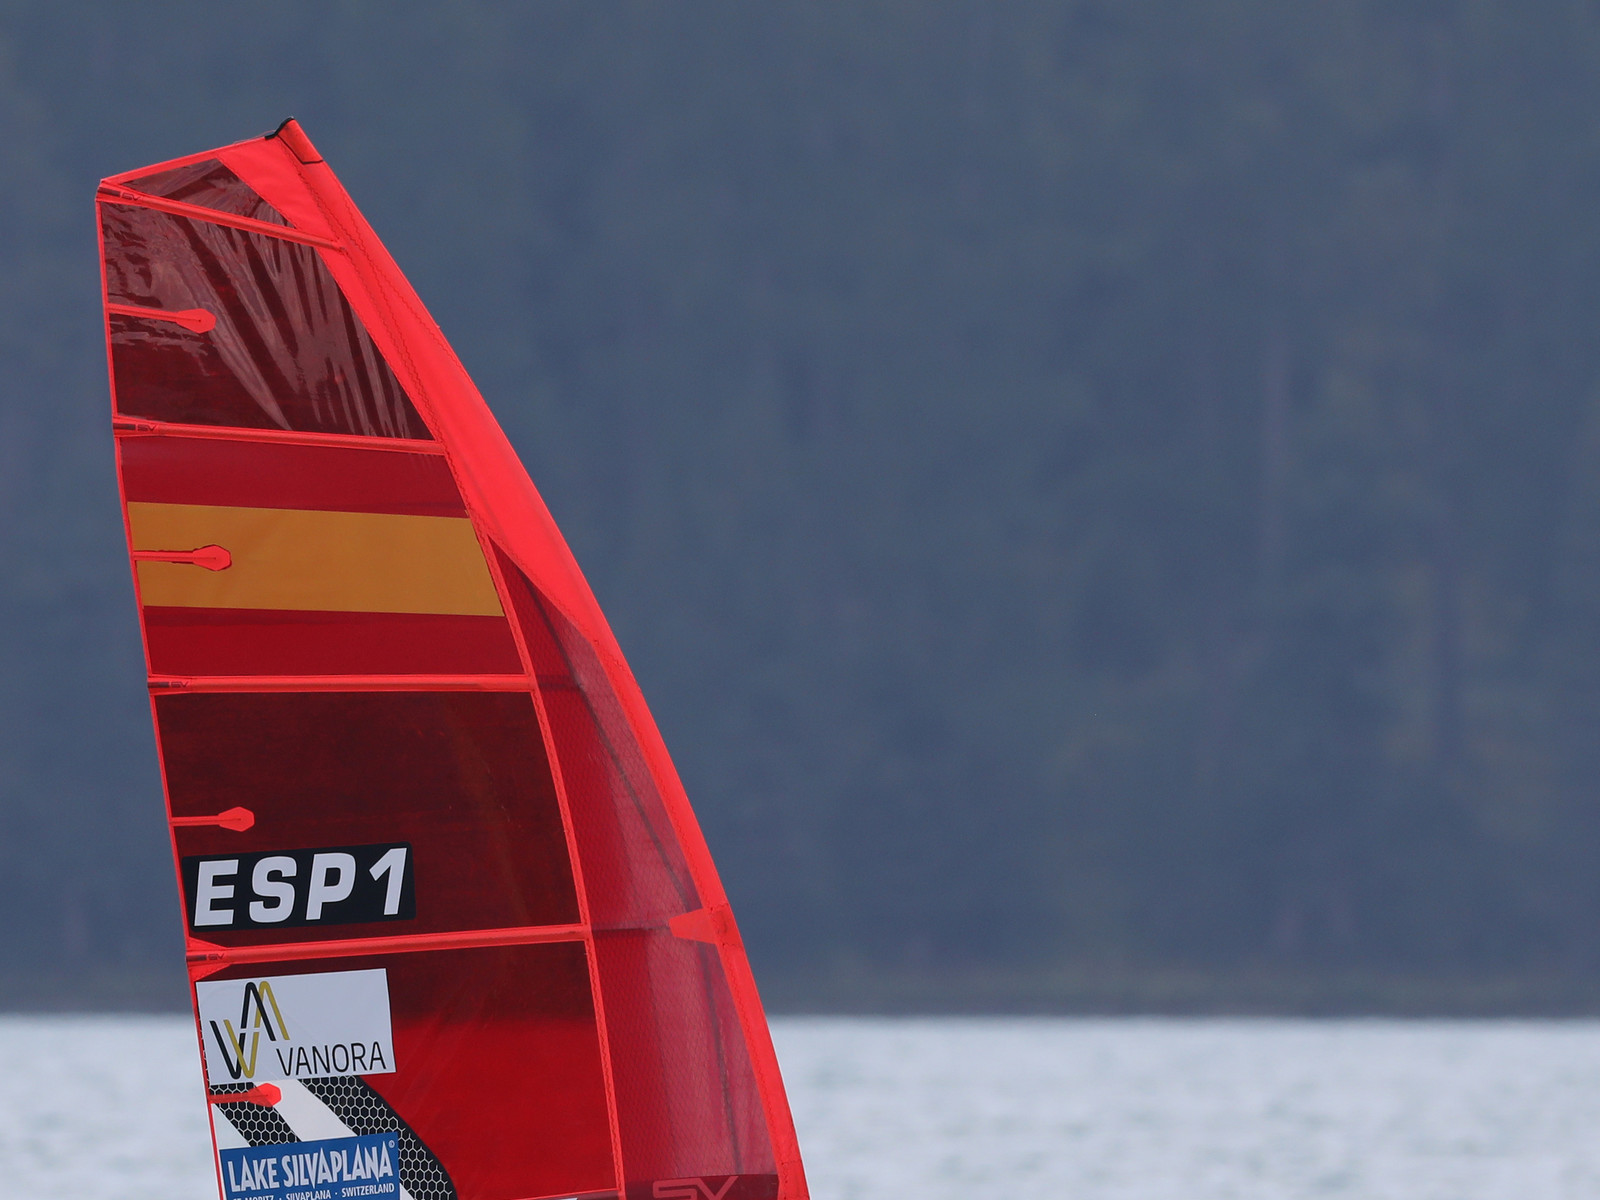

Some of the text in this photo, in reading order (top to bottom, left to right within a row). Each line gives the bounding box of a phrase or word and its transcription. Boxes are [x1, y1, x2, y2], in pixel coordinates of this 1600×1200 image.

[276, 1041, 386, 1077] VANORA
[227, 1155, 280, 1192] LAKE
[341, 1183, 395, 1198] SWITZERLAND
